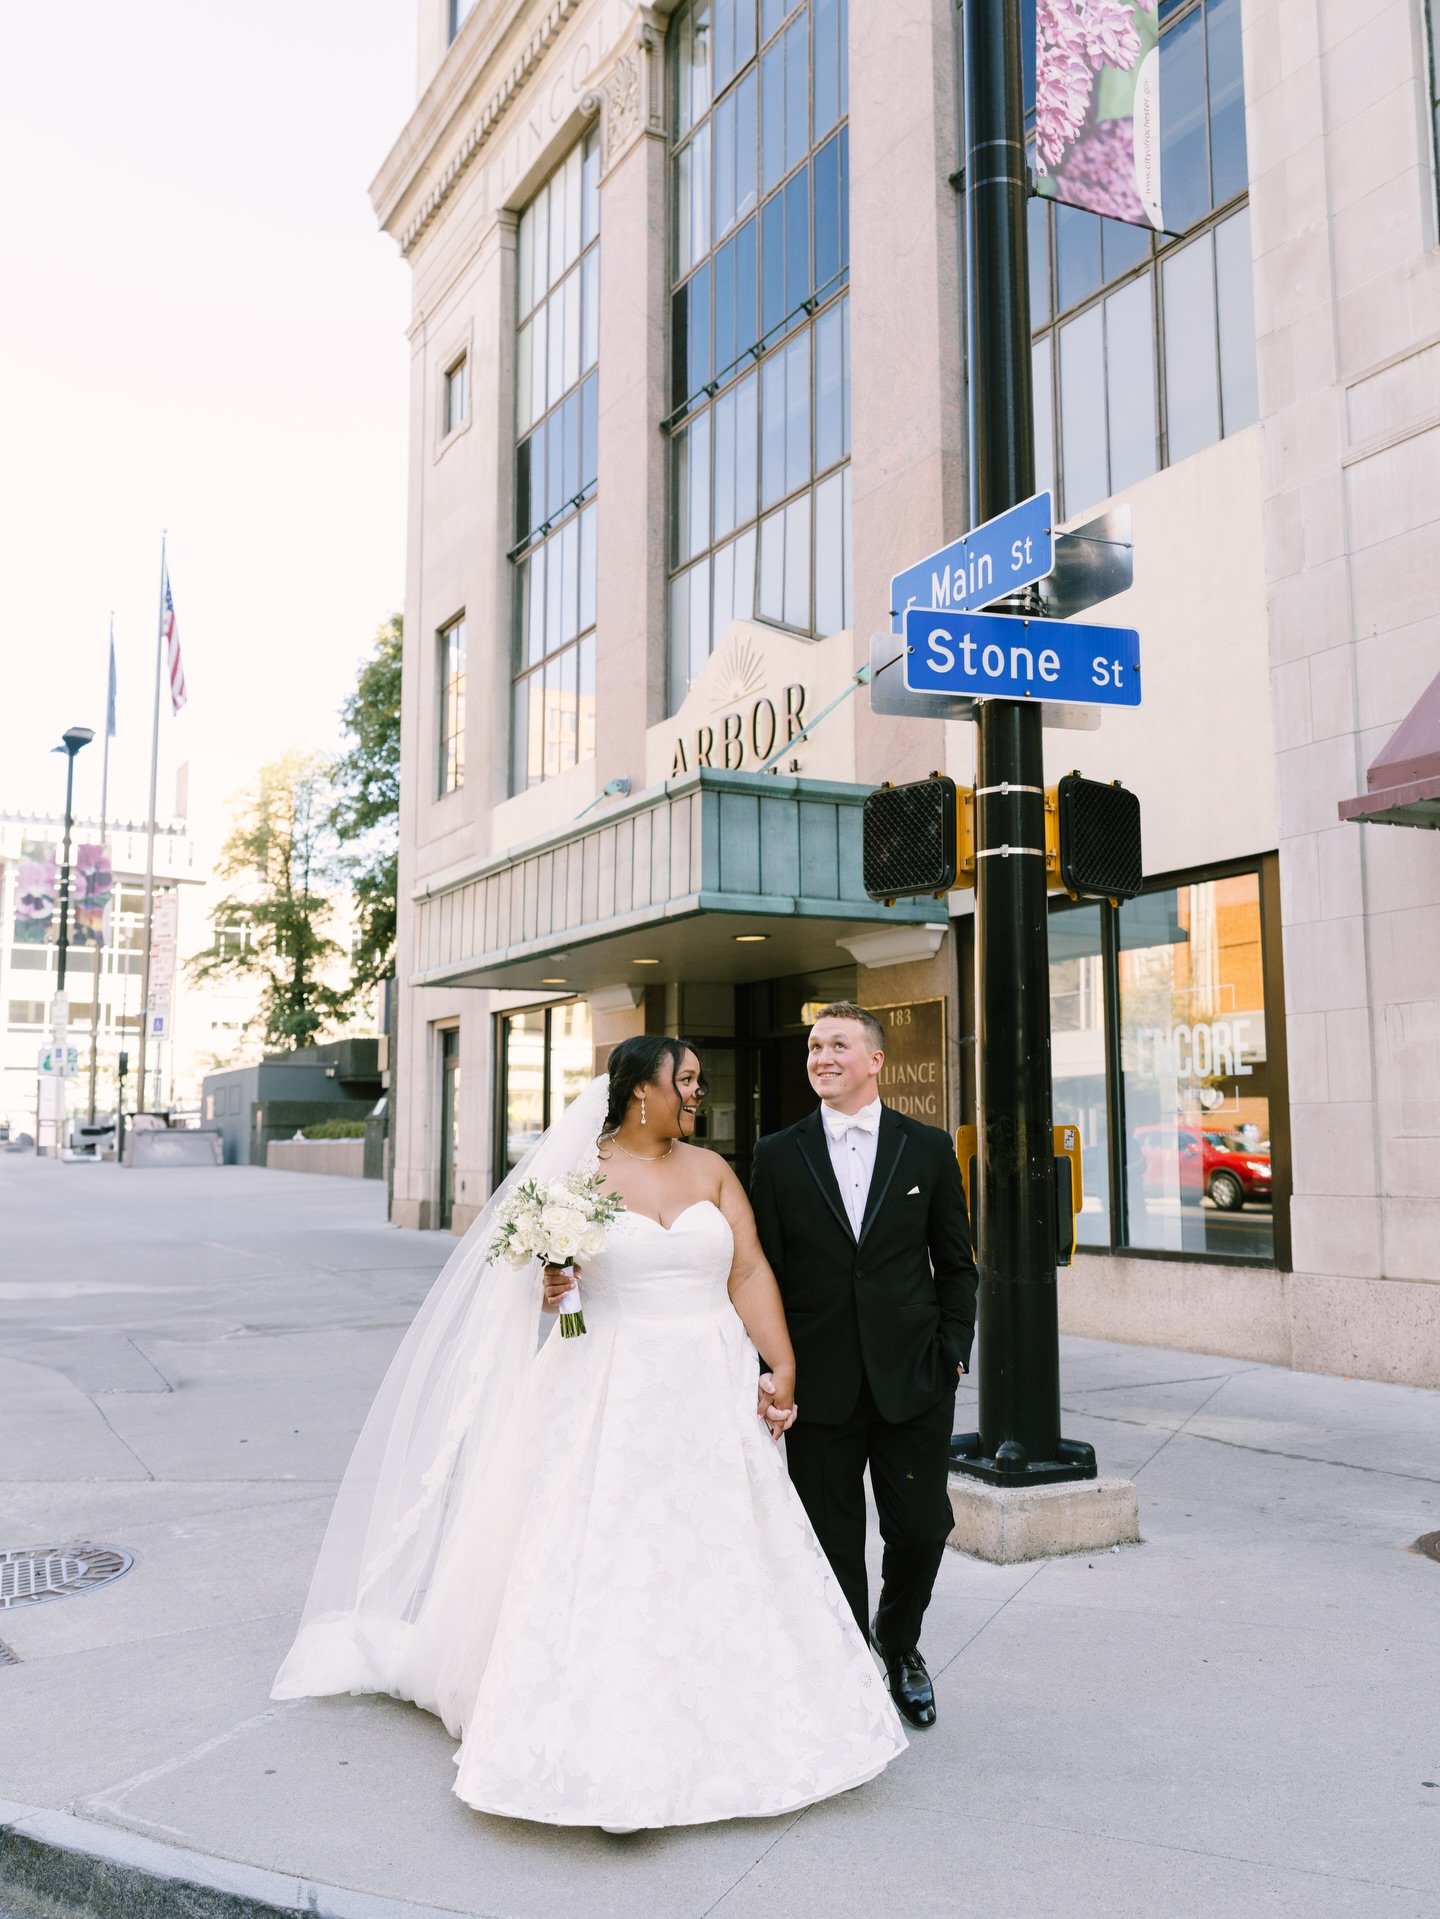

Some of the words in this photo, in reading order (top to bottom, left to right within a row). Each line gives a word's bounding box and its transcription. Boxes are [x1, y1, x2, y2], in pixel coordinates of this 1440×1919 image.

[931, 551, 993, 609] Main
[1010, 535, 1033, 572] St
[926, 628, 1061, 682] Stone
[1091, 656, 1124, 688] St
[670, 683, 809, 778] ARBOR
[889, 1008, 912, 1027] 183
[878, 1062, 937, 1086] LLIANCE
[1136, 1019, 1253, 1079] ENCORE
